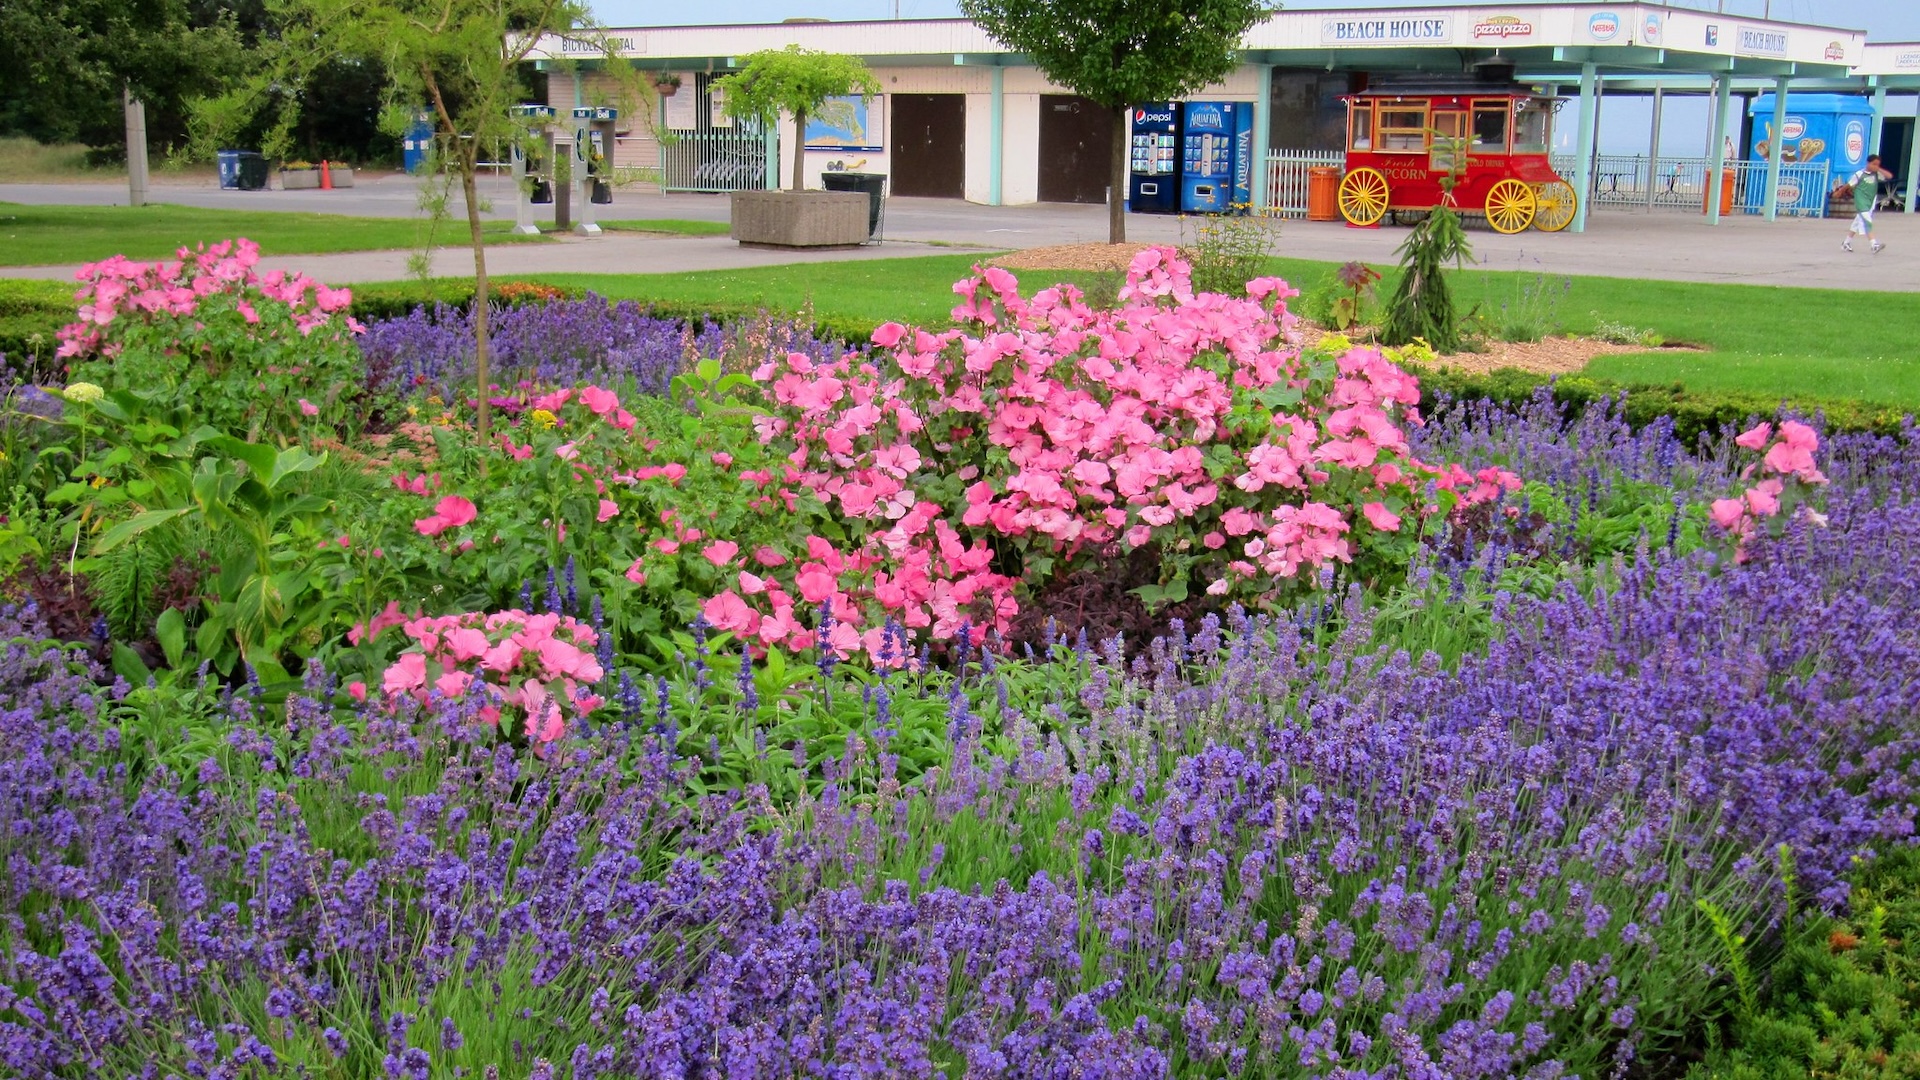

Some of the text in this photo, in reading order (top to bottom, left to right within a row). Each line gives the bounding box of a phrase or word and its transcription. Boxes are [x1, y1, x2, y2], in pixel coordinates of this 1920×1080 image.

[1336, 21, 1385, 39] BEACH
[1390, 20, 1444, 38] HOUSE
[1475, 24, 1530, 37] pizza pizza
[601, 38, 635, 50] RTAL
[1744, 31, 1764, 49] BEACH
[1765, 34, 1785, 51] HOUSE
[597, 109, 609, 118] Bell
[1147, 112, 1171, 122] pepsi
[1190, 112, 1222, 128] AQUAFINA
[1236, 129, 1251, 191] AQUAFINA
[1381, 157, 1415, 167] Fresh
[1377, 168, 1427, 180] OPCORN
